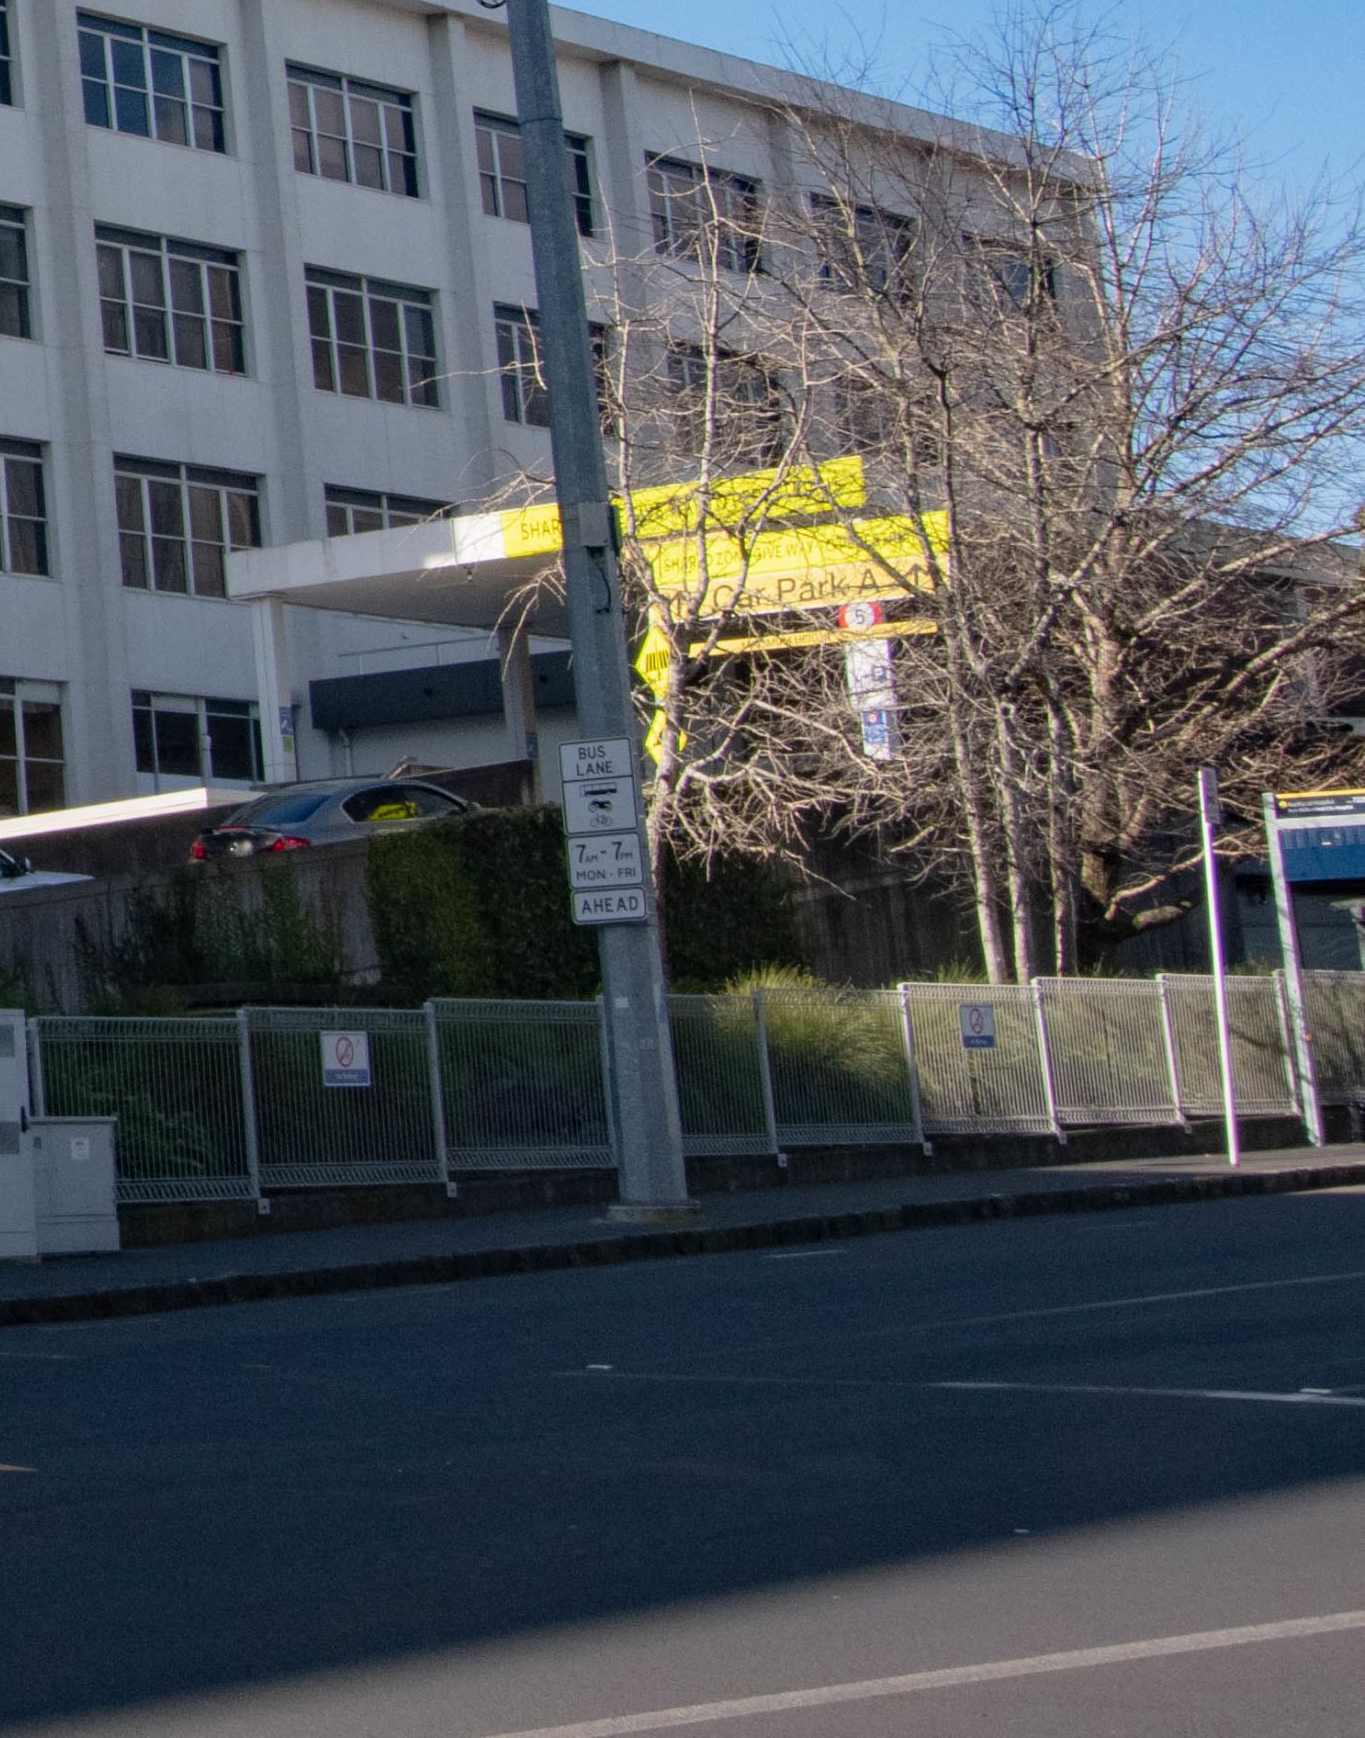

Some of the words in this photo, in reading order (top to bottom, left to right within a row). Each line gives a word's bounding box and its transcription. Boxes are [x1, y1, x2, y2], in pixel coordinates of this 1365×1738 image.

[712, 584, 766, 611] Car
[776, 572, 847, 602] Park
[857, 569, 878, 595] A
[855, 609, 865, 625] 5
[578, 745, 606, 760] BUS
[576, 761, 613, 777] LANE
[576, 869, 606, 881] MON
[617, 866, 636, 878] FRI
[581, 896, 639, 915] AHEAD
